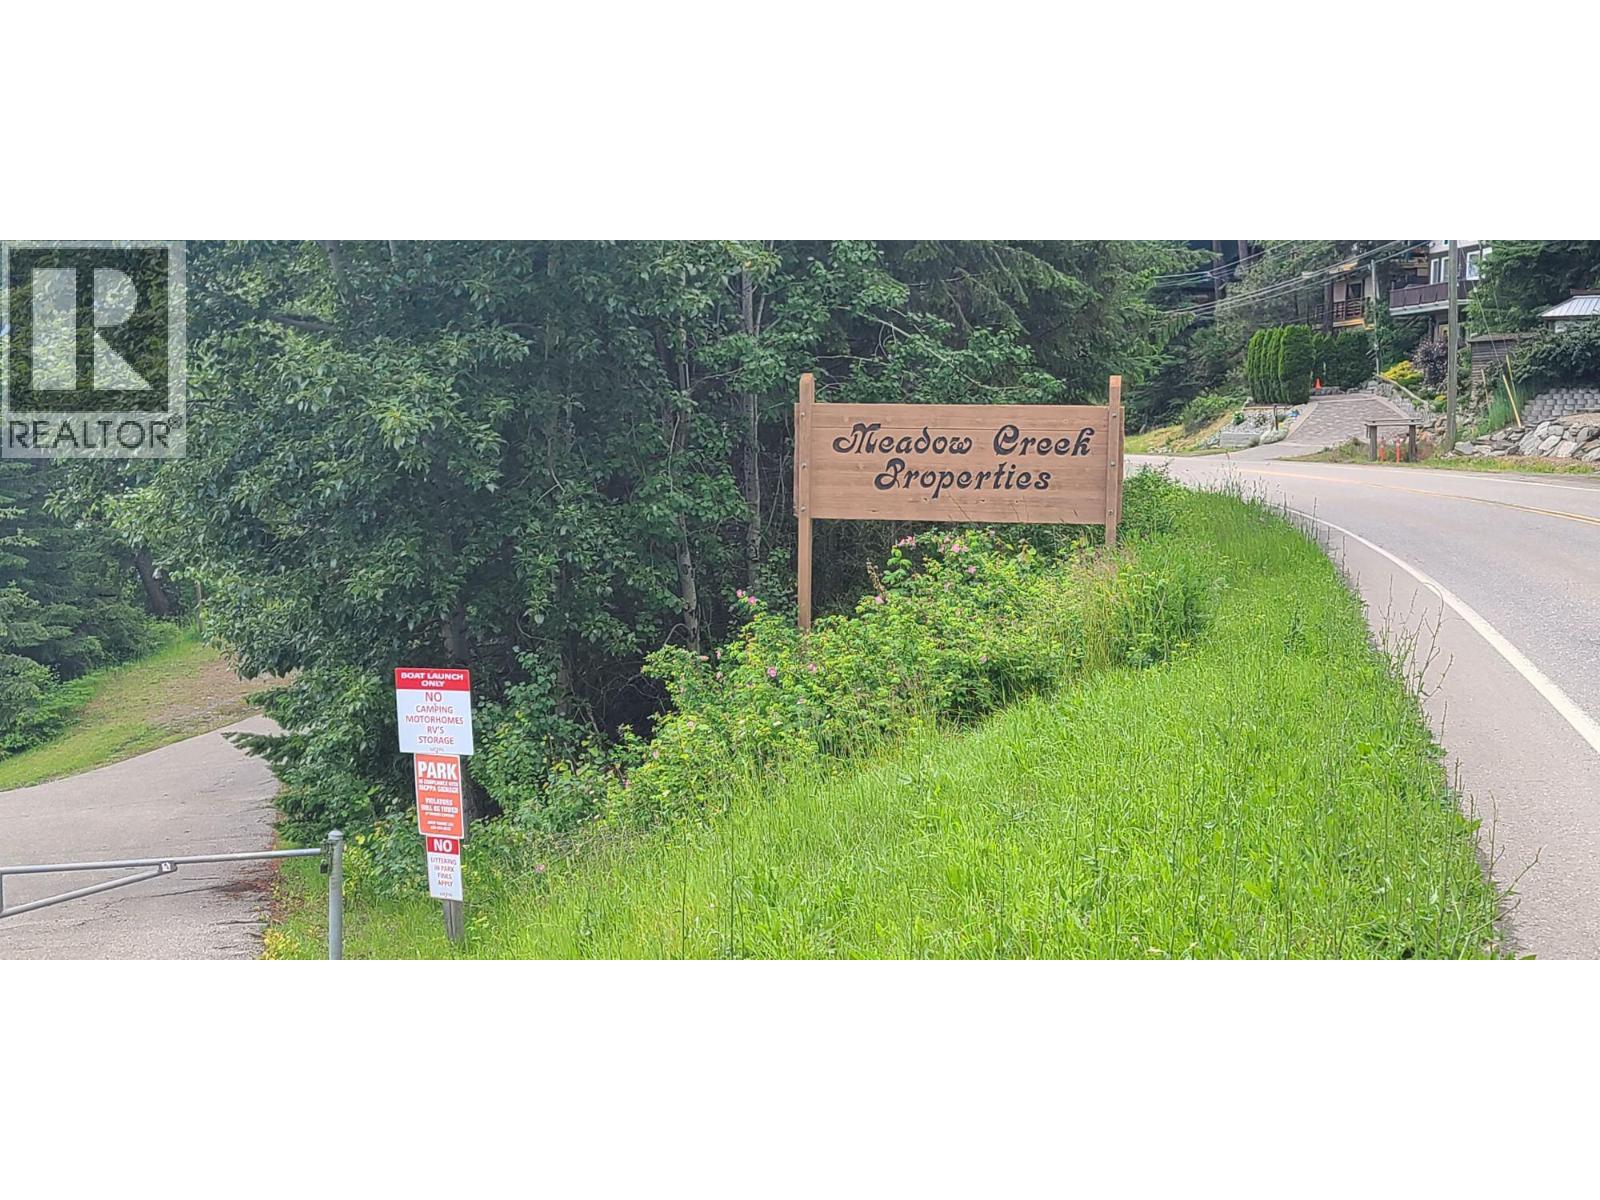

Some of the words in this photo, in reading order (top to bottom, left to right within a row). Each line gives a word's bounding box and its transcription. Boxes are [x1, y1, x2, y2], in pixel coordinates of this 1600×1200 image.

[832, 423, 973, 454] Meadow
[993, 424, 1095, 457] Creek
[873, 457, 1052, 499] Properties
[427, 673, 464, 681] LAUNCH
[425, 692, 442, 702] NO
[416, 705, 454, 714] CAMPING
[405, 715, 464, 725] MOTORHOMES
[427, 726, 445, 734] RV'S
[418, 736, 455, 745] STORAGE
[417, 761, 457, 780] PARK
[433, 839, 453, 852] NO
[431, 857, 457, 865] LITTERING
